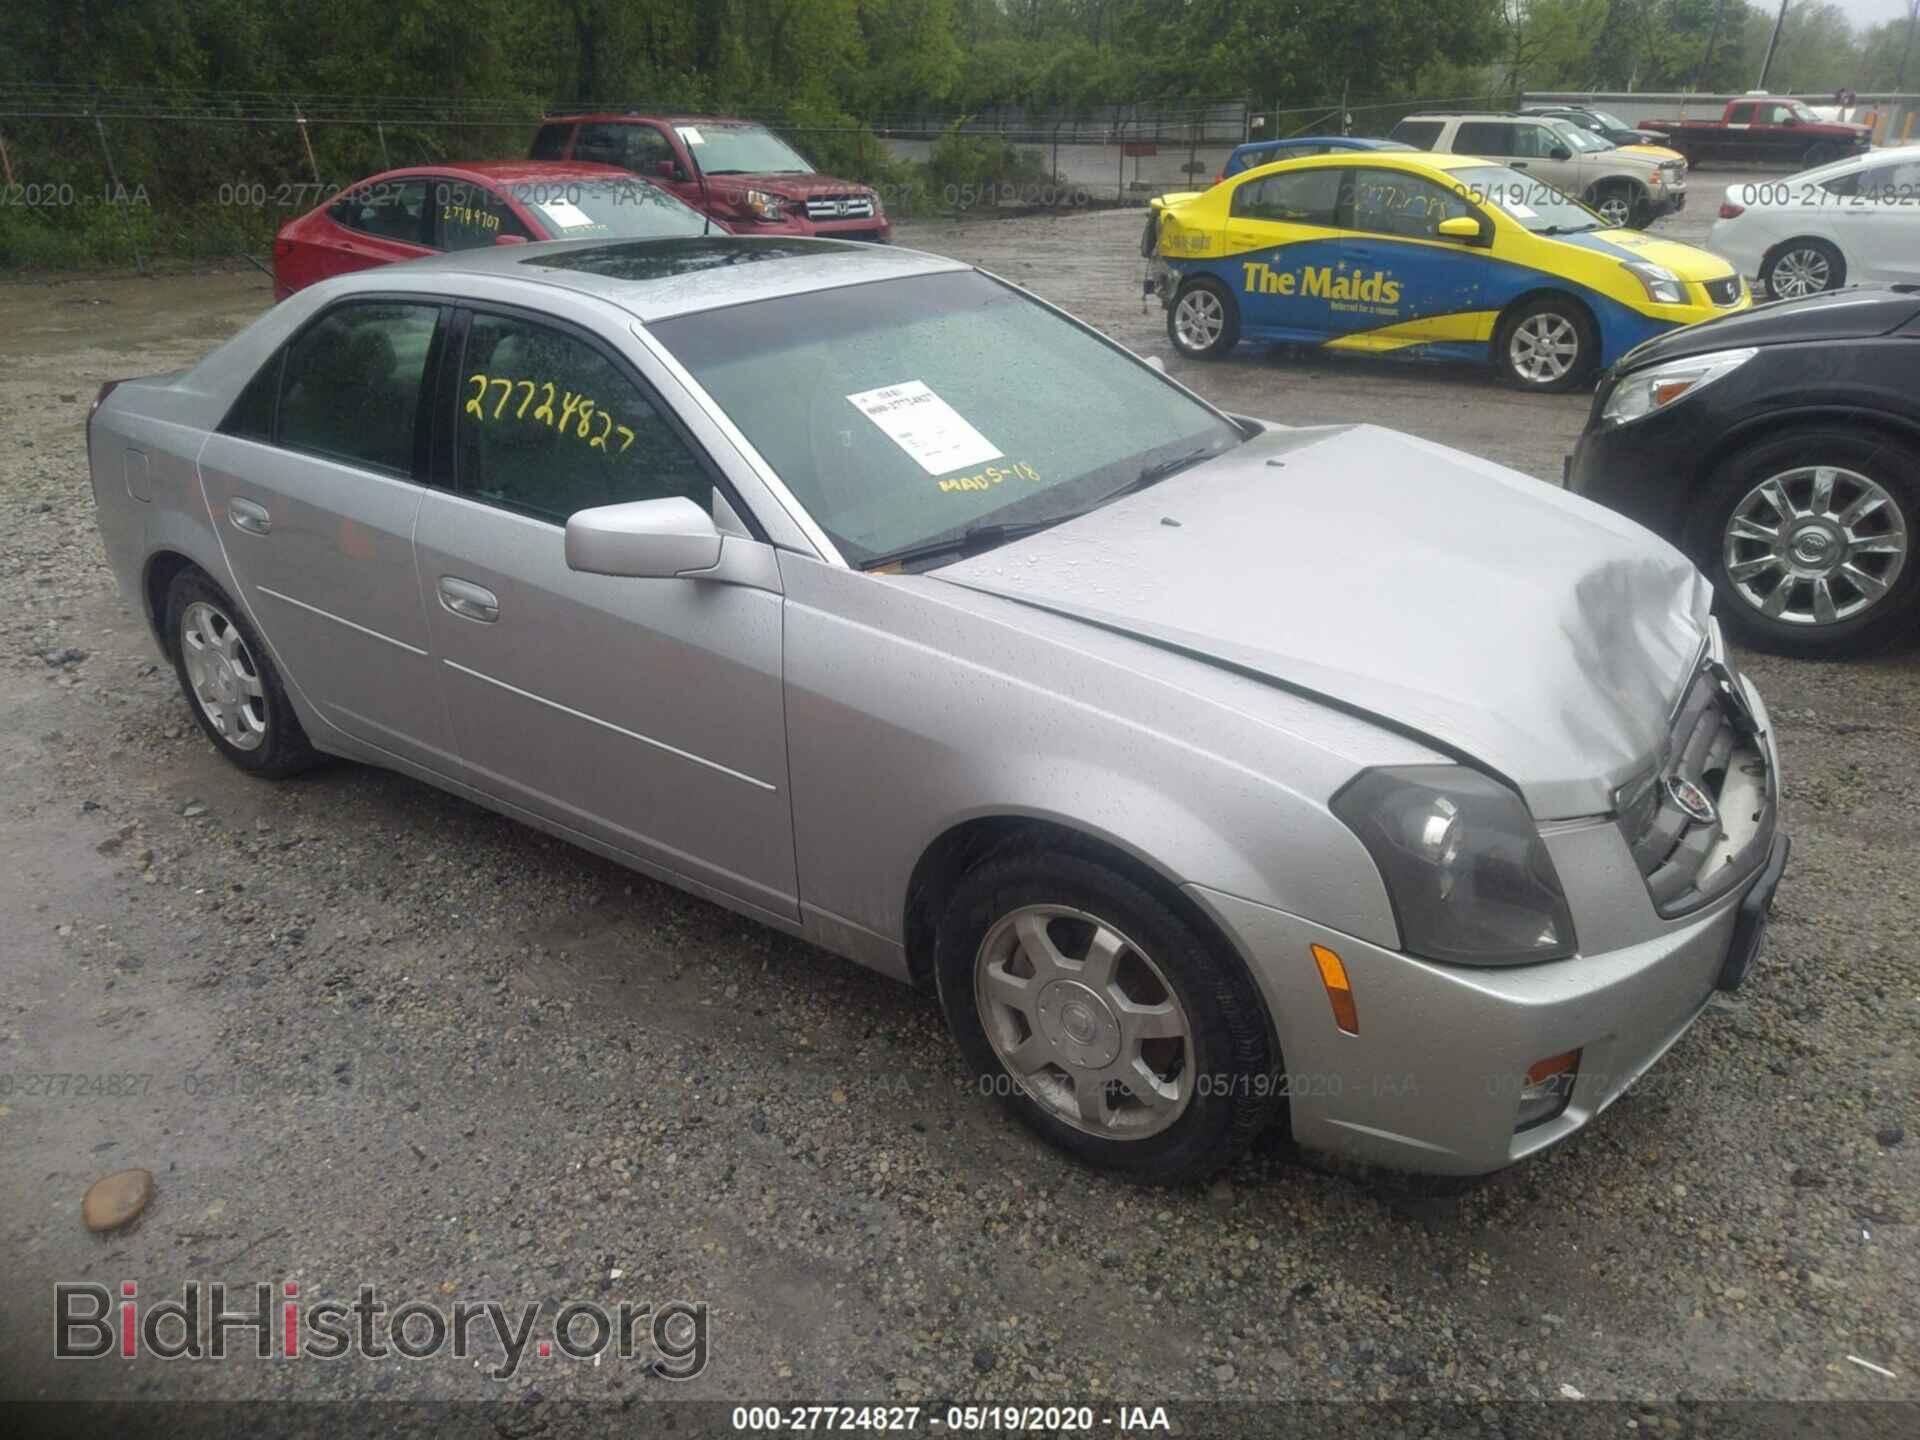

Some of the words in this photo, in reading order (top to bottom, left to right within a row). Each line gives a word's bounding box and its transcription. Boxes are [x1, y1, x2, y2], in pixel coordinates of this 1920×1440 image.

[1243, 261, 1296, 295] The
[1300, 265, 1400, 304] Maids
[466, 373, 635, 453] 27724827
